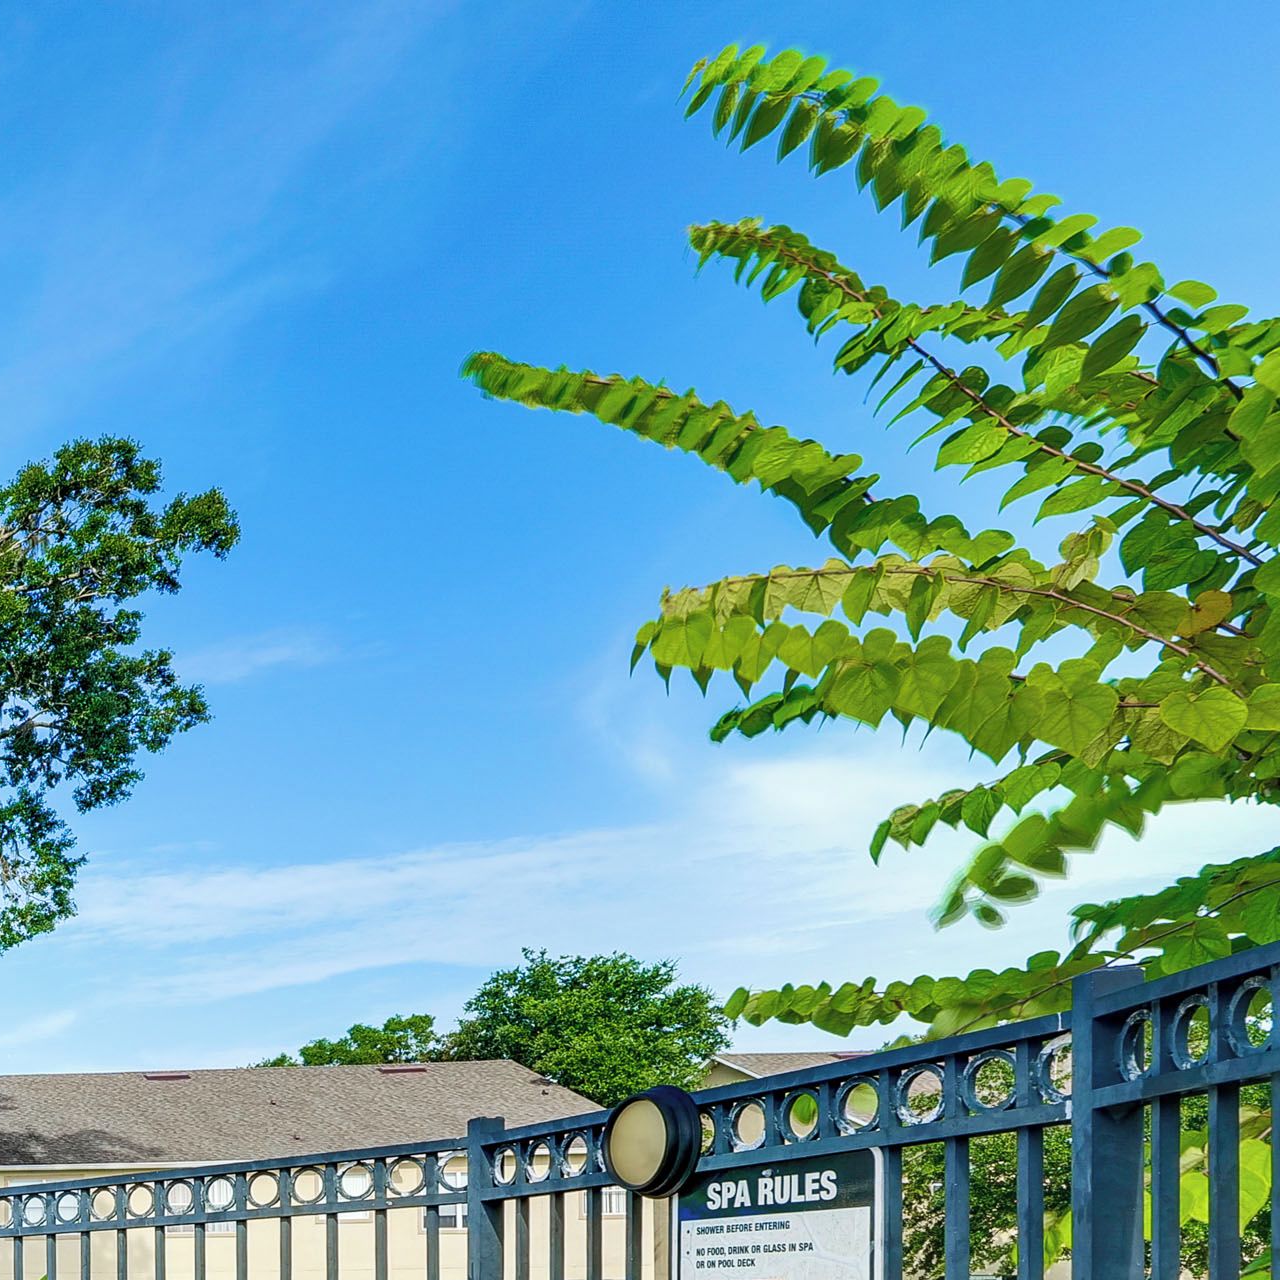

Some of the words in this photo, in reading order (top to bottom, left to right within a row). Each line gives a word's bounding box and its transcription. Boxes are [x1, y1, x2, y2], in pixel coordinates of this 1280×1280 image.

[706, 1180, 751, 1211] SPA
[758, 1170, 837, 1206] RULES
[696, 1223, 724, 1235] SHOWER
[726, 1222, 753, 1233] BEFORE
[754, 1220, 790, 1232] ENTERING
[696, 1248, 705, 1257] NO
[728, 1245, 749, 1255] DRINK
[751, 1245, 762, 1254] OR
[763, 1243, 787, 1253] GLASS
[788, 1243, 797, 1251] IN
[798, 1242, 814, 1251] SPA
[696, 1260, 705, 1269] OR
[707, 1260, 716, 1269] ON
[718, 1259, 735, 1268] POOL
[737, 1258, 756, 1267] DECK
